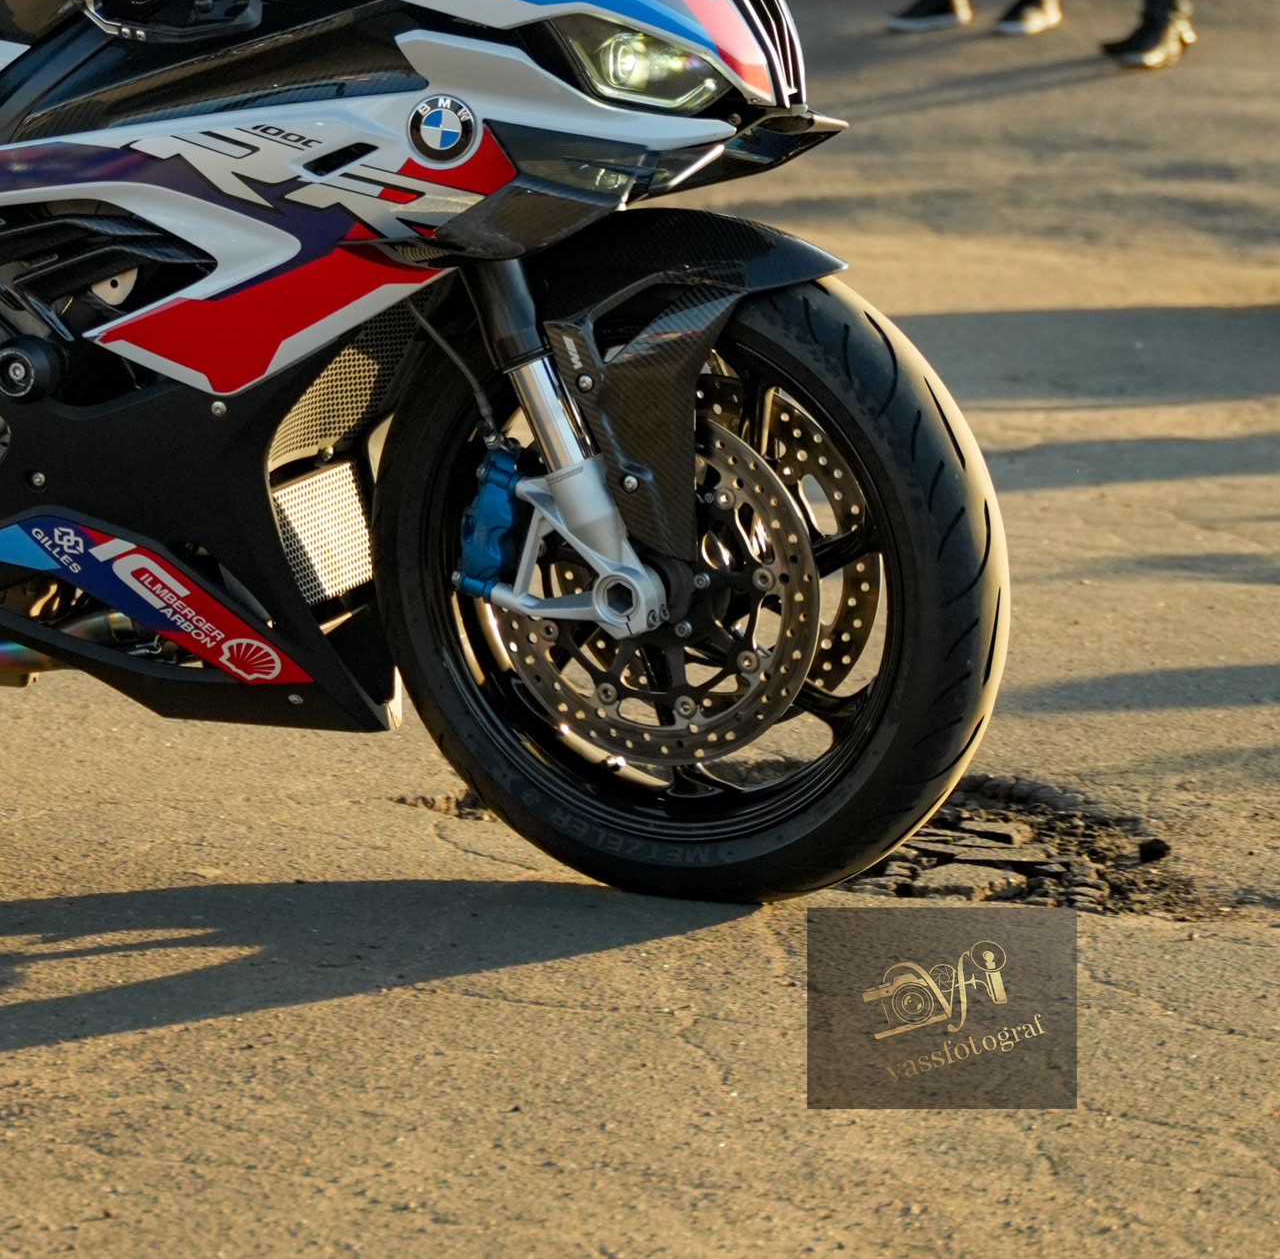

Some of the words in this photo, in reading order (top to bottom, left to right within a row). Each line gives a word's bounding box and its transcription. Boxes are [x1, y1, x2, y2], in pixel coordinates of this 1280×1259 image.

[30, 526, 83, 575] GILLES
[137, 572, 227, 643] ILMBERGER
[548, 806, 711, 865] METZELER
